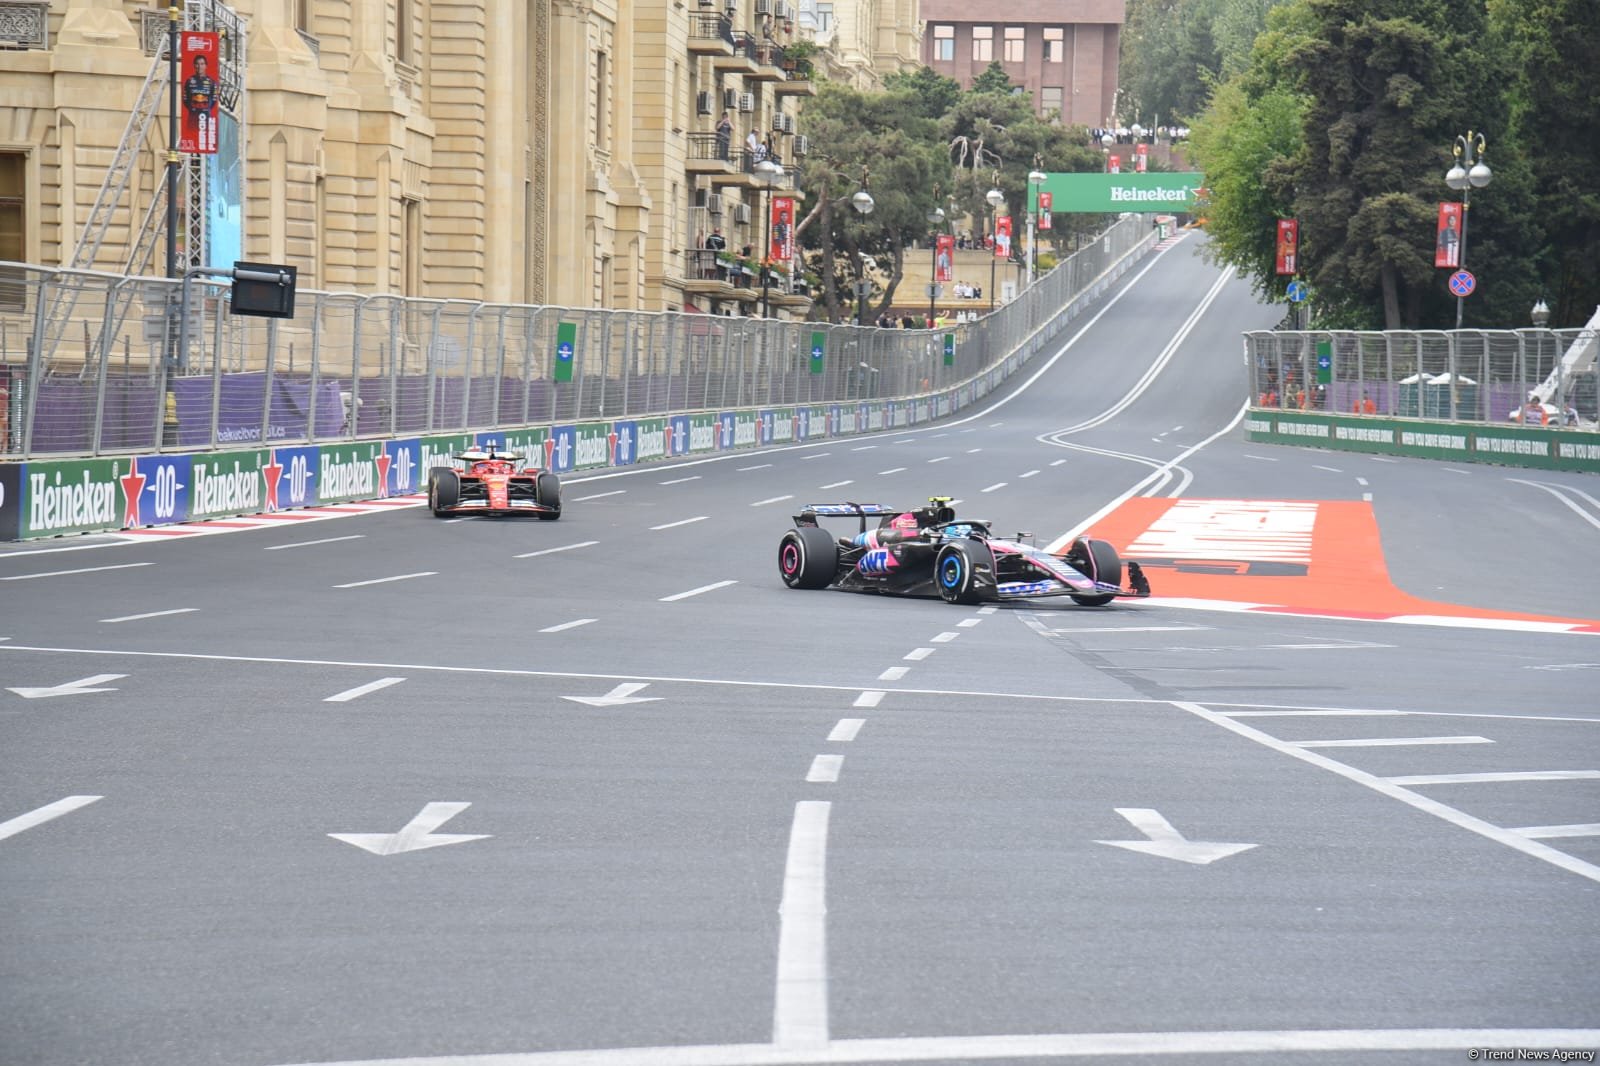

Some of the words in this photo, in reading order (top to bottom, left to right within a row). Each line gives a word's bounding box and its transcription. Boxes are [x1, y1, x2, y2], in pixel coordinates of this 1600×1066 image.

[1110, 186, 1187, 201] Heineken
[1476, 437, 1490, 451] WHEN
[1490, 437, 1500, 452] YOU
[1501, 438, 1515, 453] DRIVE
[1515, 439, 1531, 454] NEVER
[1531, 441, 1549, 456] DRINK
[1559, 442, 1575, 458] WHEN
[1575, 443, 1586, 459] YOU
[155, 464, 176, 518] 0.0
[193, 461, 259, 515] Heineken
[319, 451, 373, 500] Heineken
[29, 470, 116, 531] Heineken
